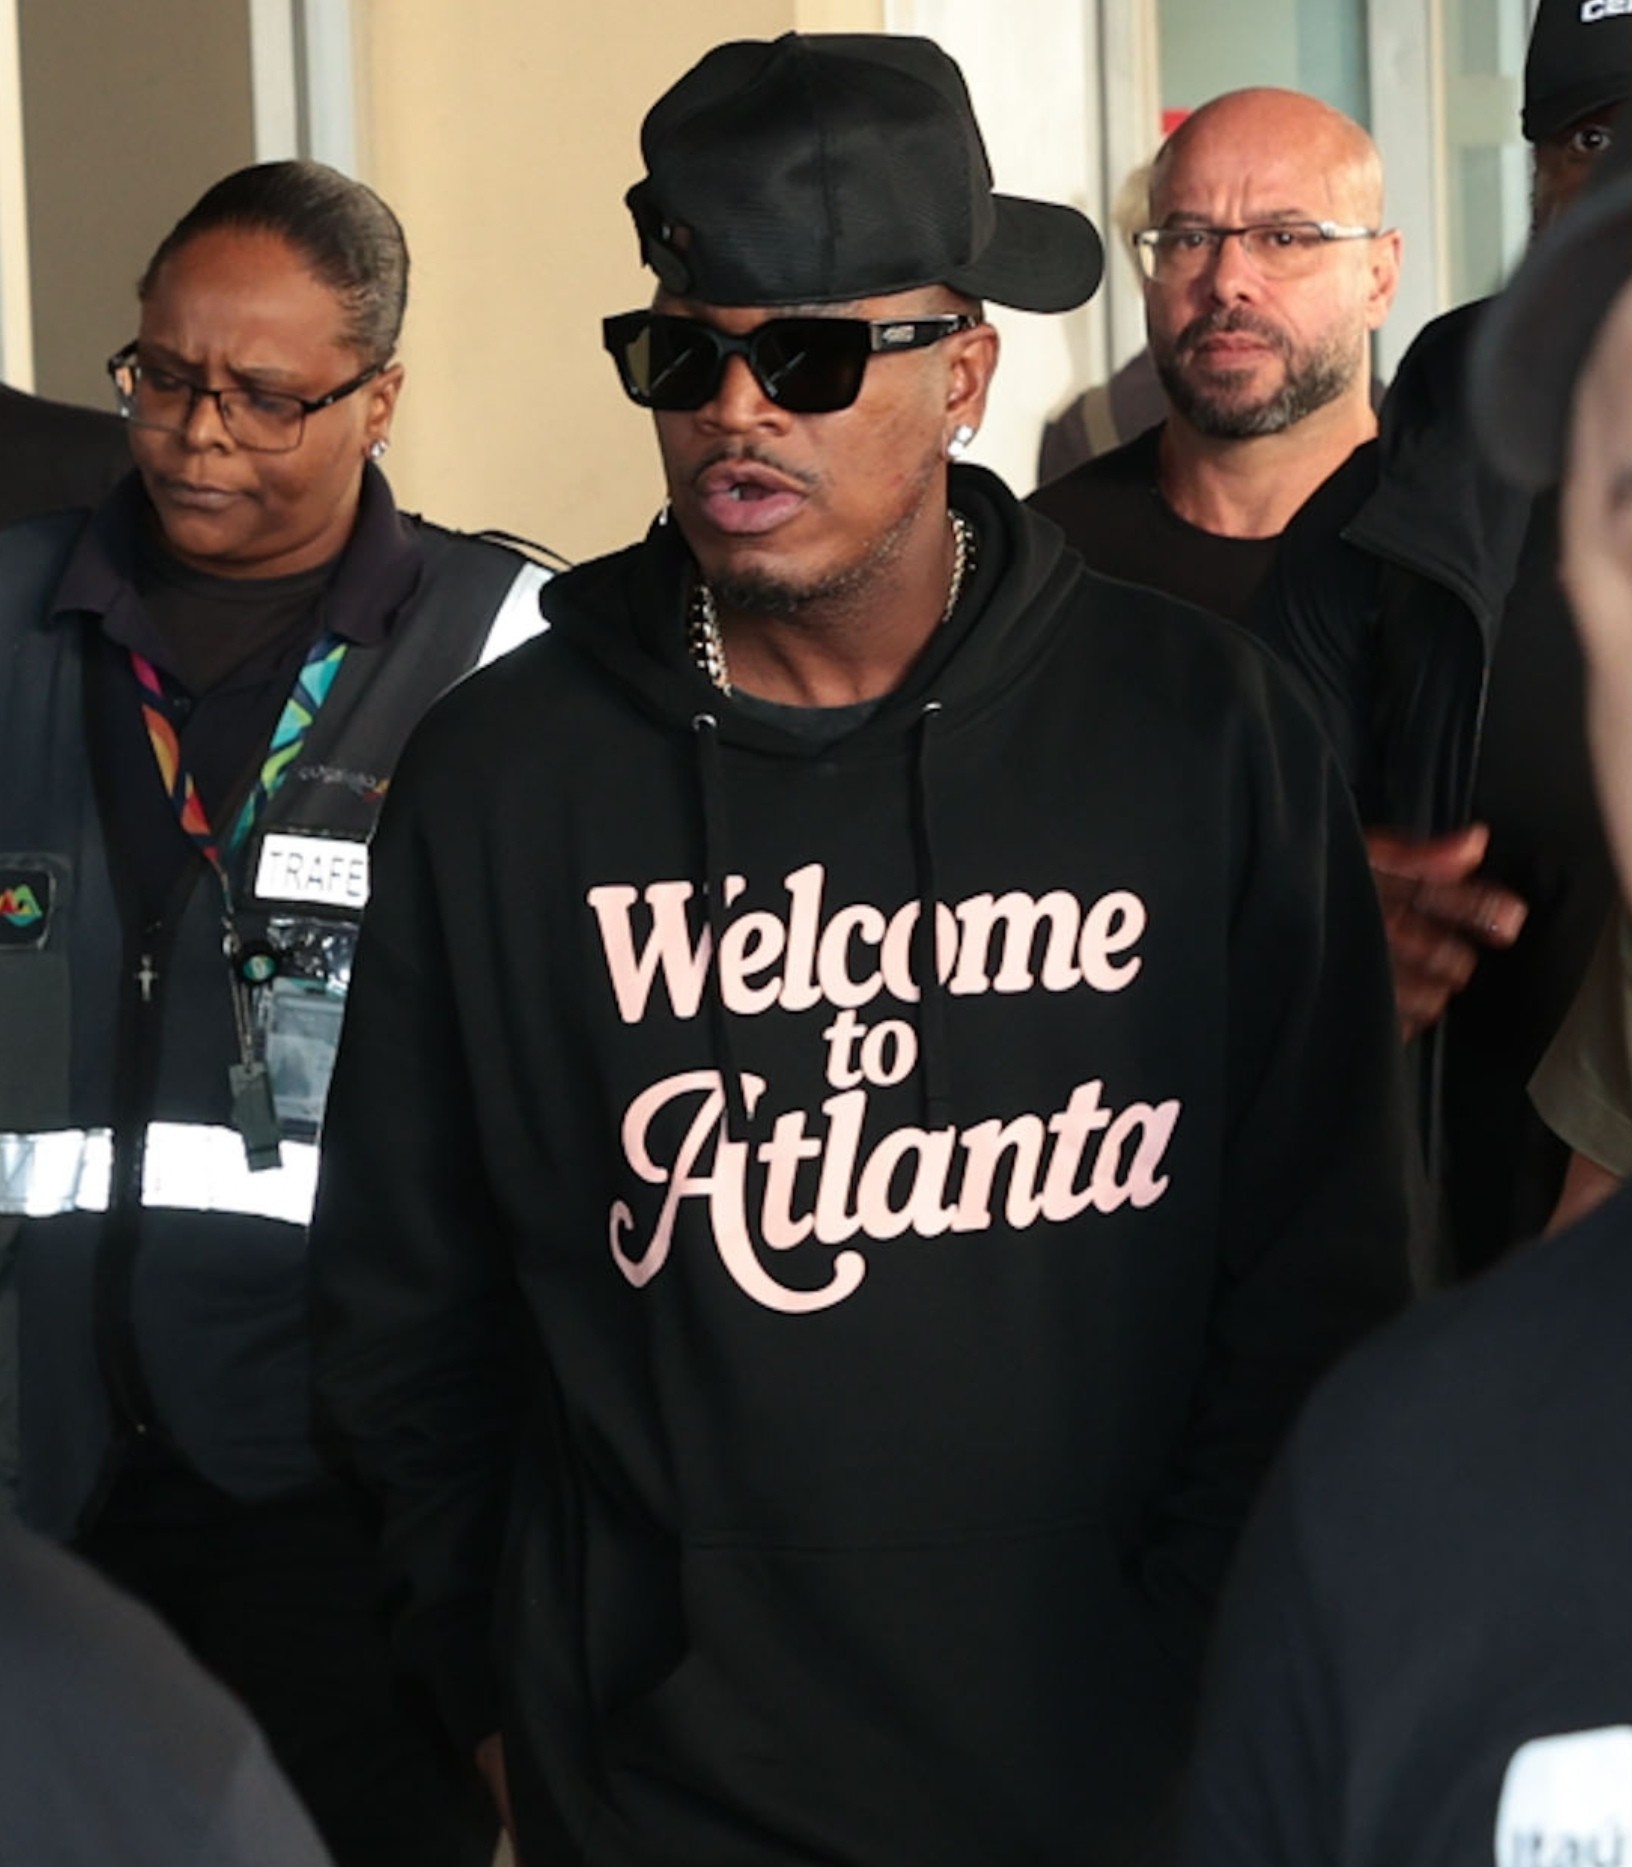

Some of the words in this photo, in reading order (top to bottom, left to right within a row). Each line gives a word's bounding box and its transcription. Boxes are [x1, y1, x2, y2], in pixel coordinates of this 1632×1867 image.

[586, 863, 1146, 1023] Welcome
[823, 1009, 917, 1089] to
[609, 1069, 1181, 1314] Atlanta
